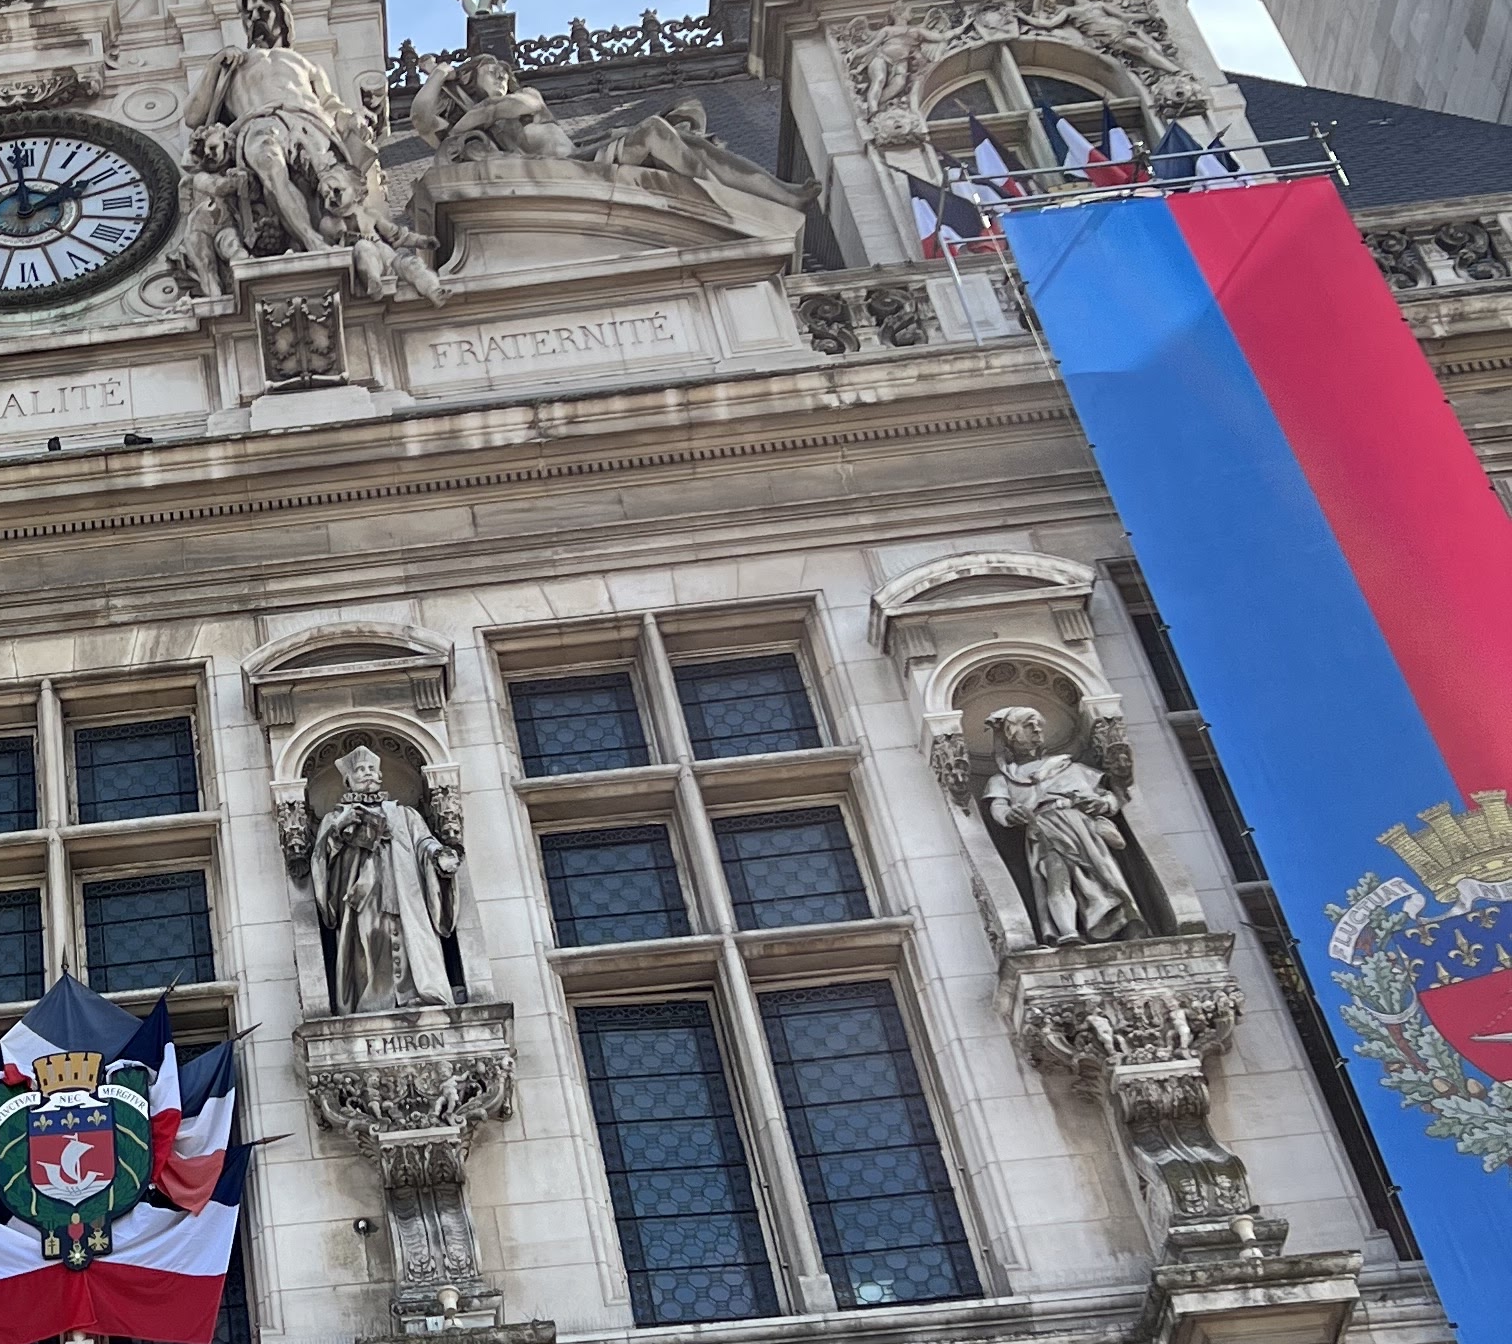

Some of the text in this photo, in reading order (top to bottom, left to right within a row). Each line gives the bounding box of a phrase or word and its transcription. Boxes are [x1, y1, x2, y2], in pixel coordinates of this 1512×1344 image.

[91, 167, 118, 186] II
[101, 195, 133, 212] III
[89, 222, 126, 244] IIII
[65, 250, 91, 270] V
[19, 261, 42, 284] VI
[429, 311, 675, 369] FRATERNITÉ
[1331, 881, 1512, 961] FLUCTUAT NE
[59, 1093, 83, 1104] NEC
